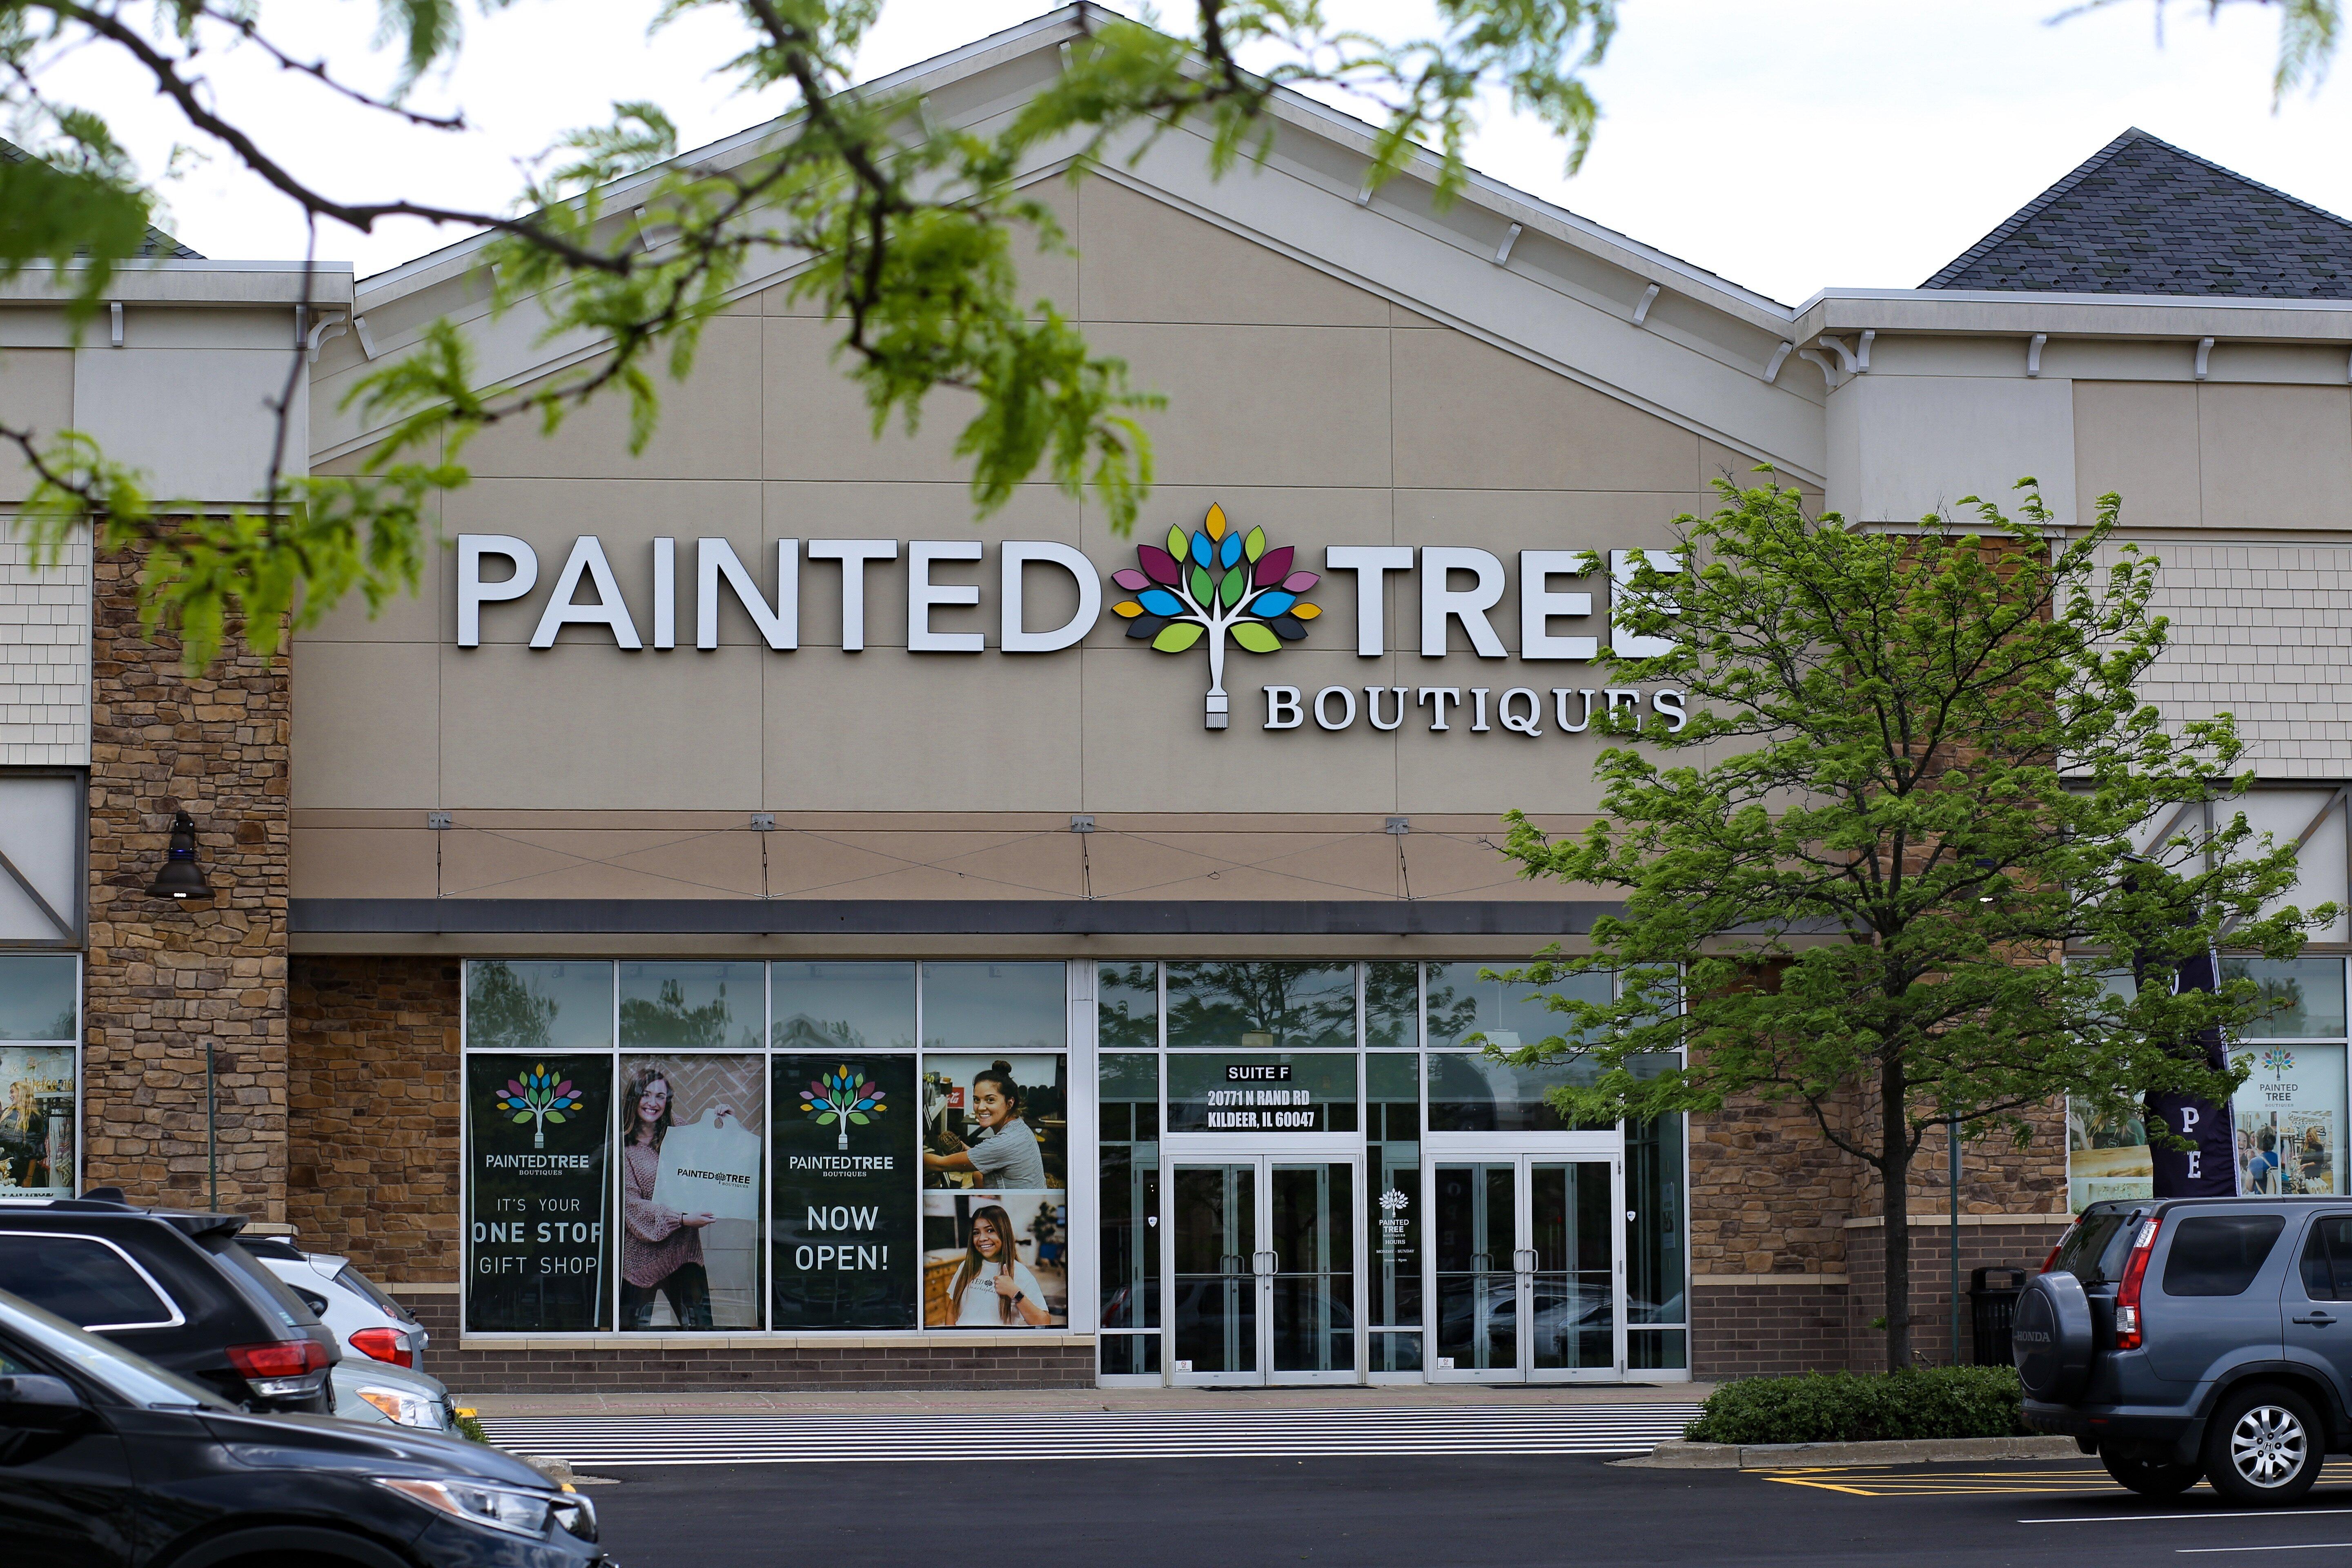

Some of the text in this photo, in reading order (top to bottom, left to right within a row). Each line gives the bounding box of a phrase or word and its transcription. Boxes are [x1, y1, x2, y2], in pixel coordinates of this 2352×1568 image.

[457, 533, 1687, 660] PAINTED TREE
[1263, 685, 1688, 737] BOUTIQUES
[1229, 1067, 1289, 1079] SUITE F
[1207, 1090, 1310, 1106] 20771 N RAND RD
[2265, 1092, 2292, 1101] TREE
[1207, 1111, 1314, 1129] KILDEER, IL 60047
[677, 1169, 751, 1184] PAINTED TREE
[497, 1199, 580, 1211] IT'S YOUR
[807, 1205, 879, 1231] NOW
[474, 1222, 525, 1243] ONE
[480, 1257, 597, 1274] GIFT SHOP
[795, 1245, 889, 1270] OPEN!
[2017, 1331, 2051, 1342] HONDA
